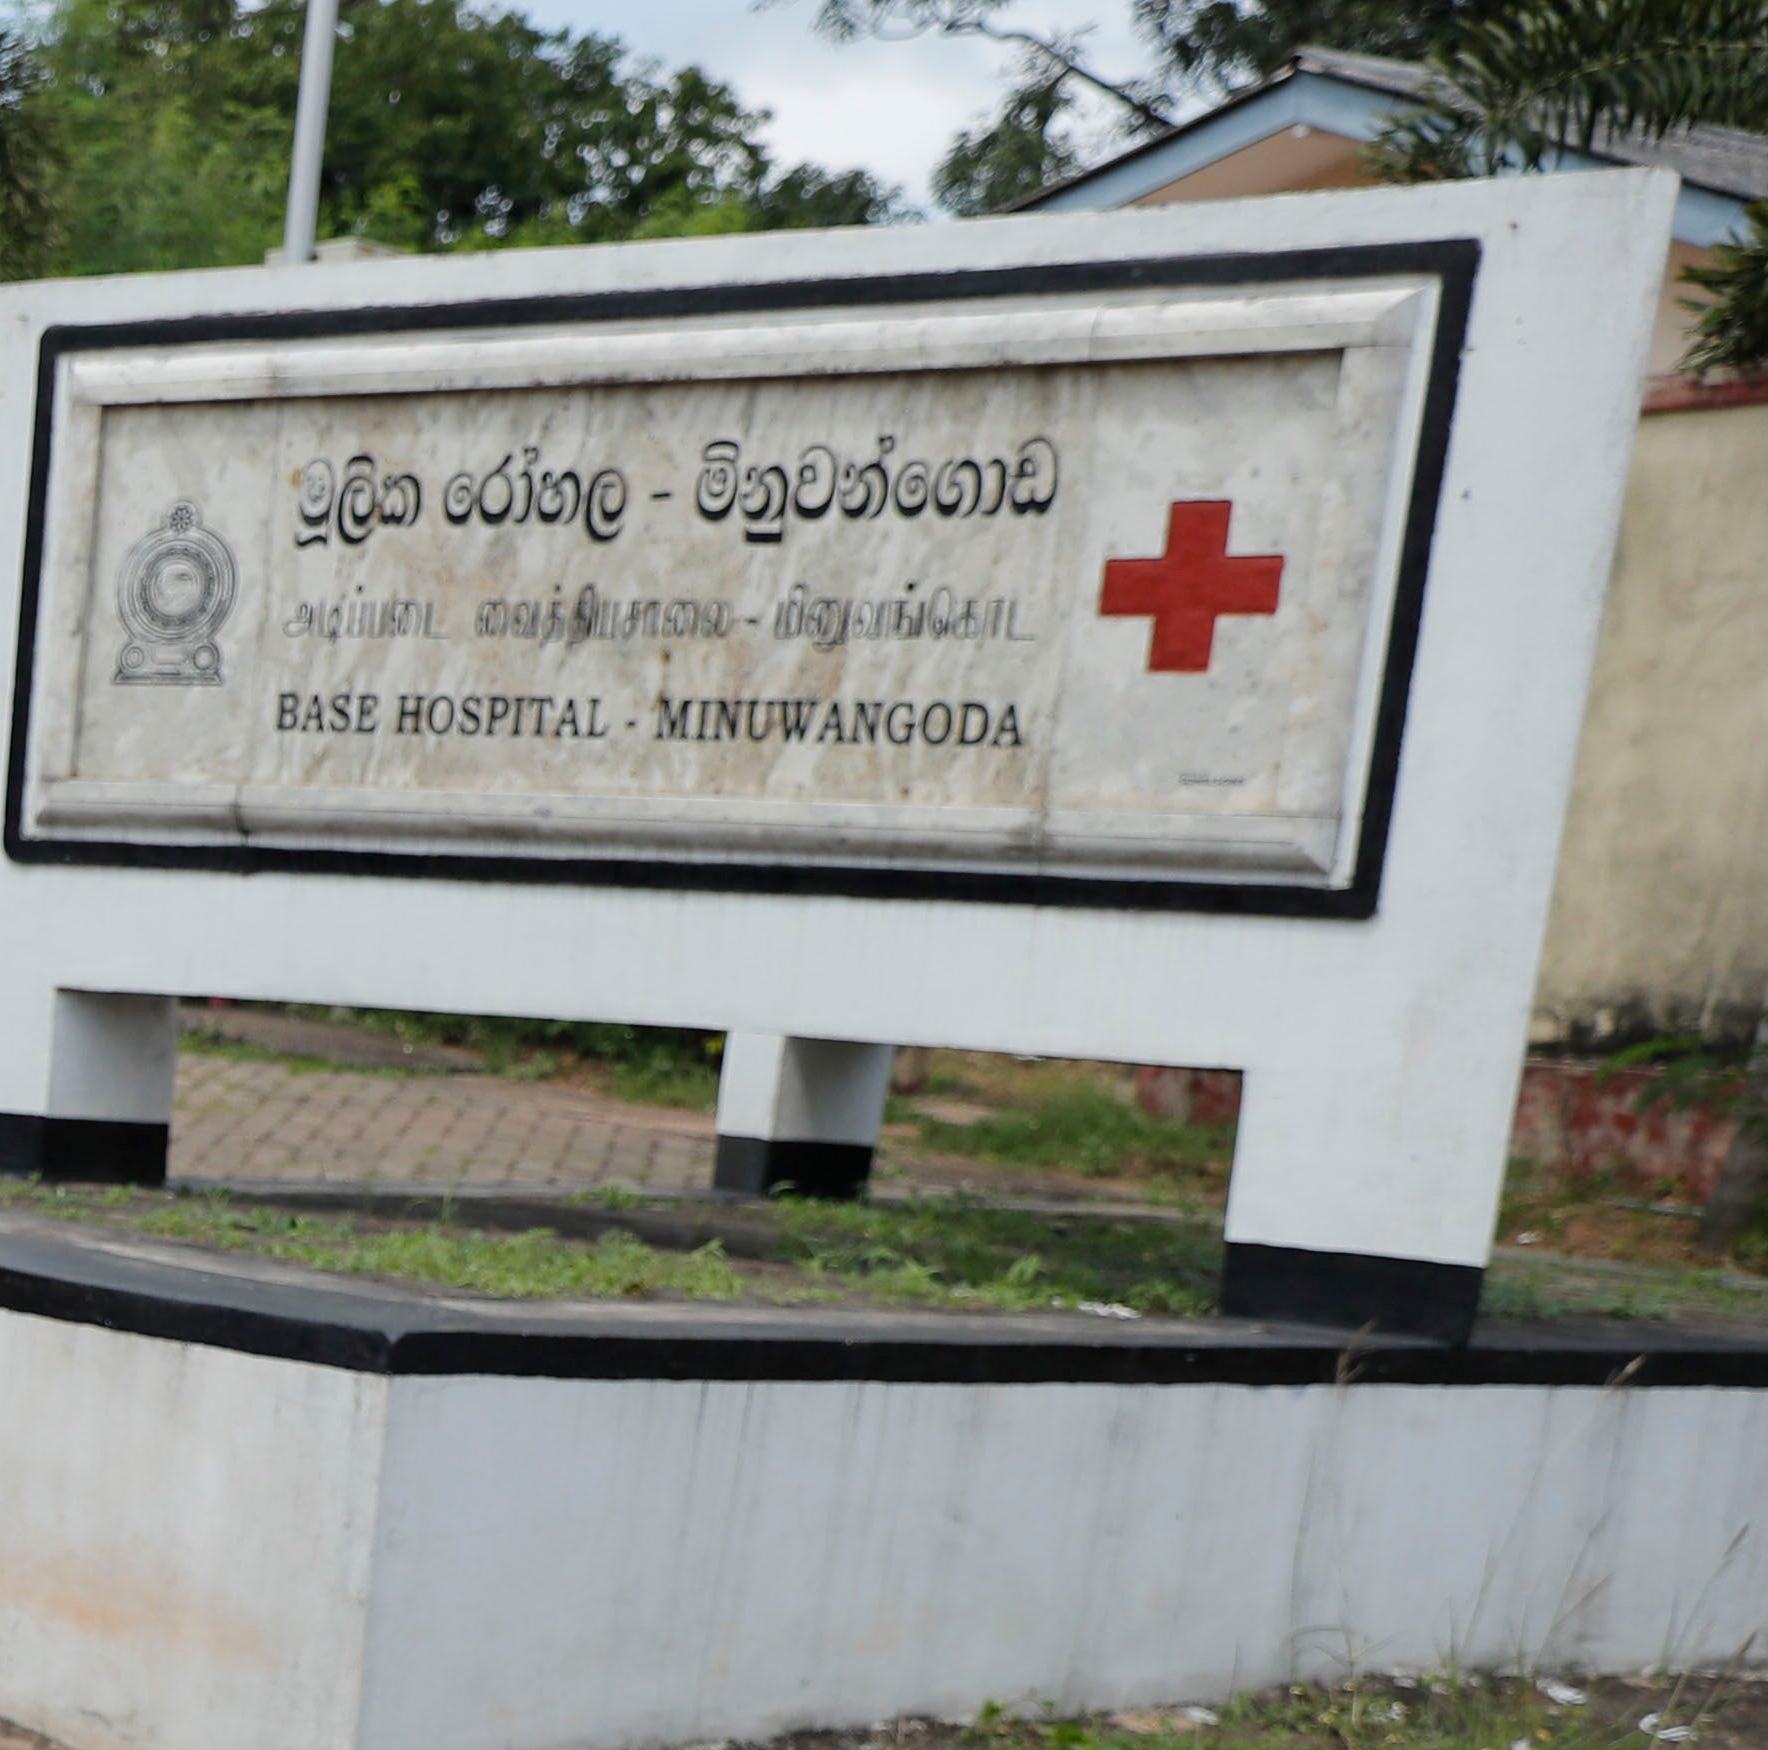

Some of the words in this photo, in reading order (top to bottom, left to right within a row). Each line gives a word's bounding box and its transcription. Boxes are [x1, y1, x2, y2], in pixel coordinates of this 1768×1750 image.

[294, 453, 422, 548] මූලික
[444, 446, 627, 541] රෝහල
[650, 490, 672, 500] -
[696, 435, 1059, 543] මිනුවන්ගොඩ
[276, 693, 378, 733] BASE
[395, 695, 610, 738] HOSPITAL
[655, 699, 1022, 747] MINUWANGODA
